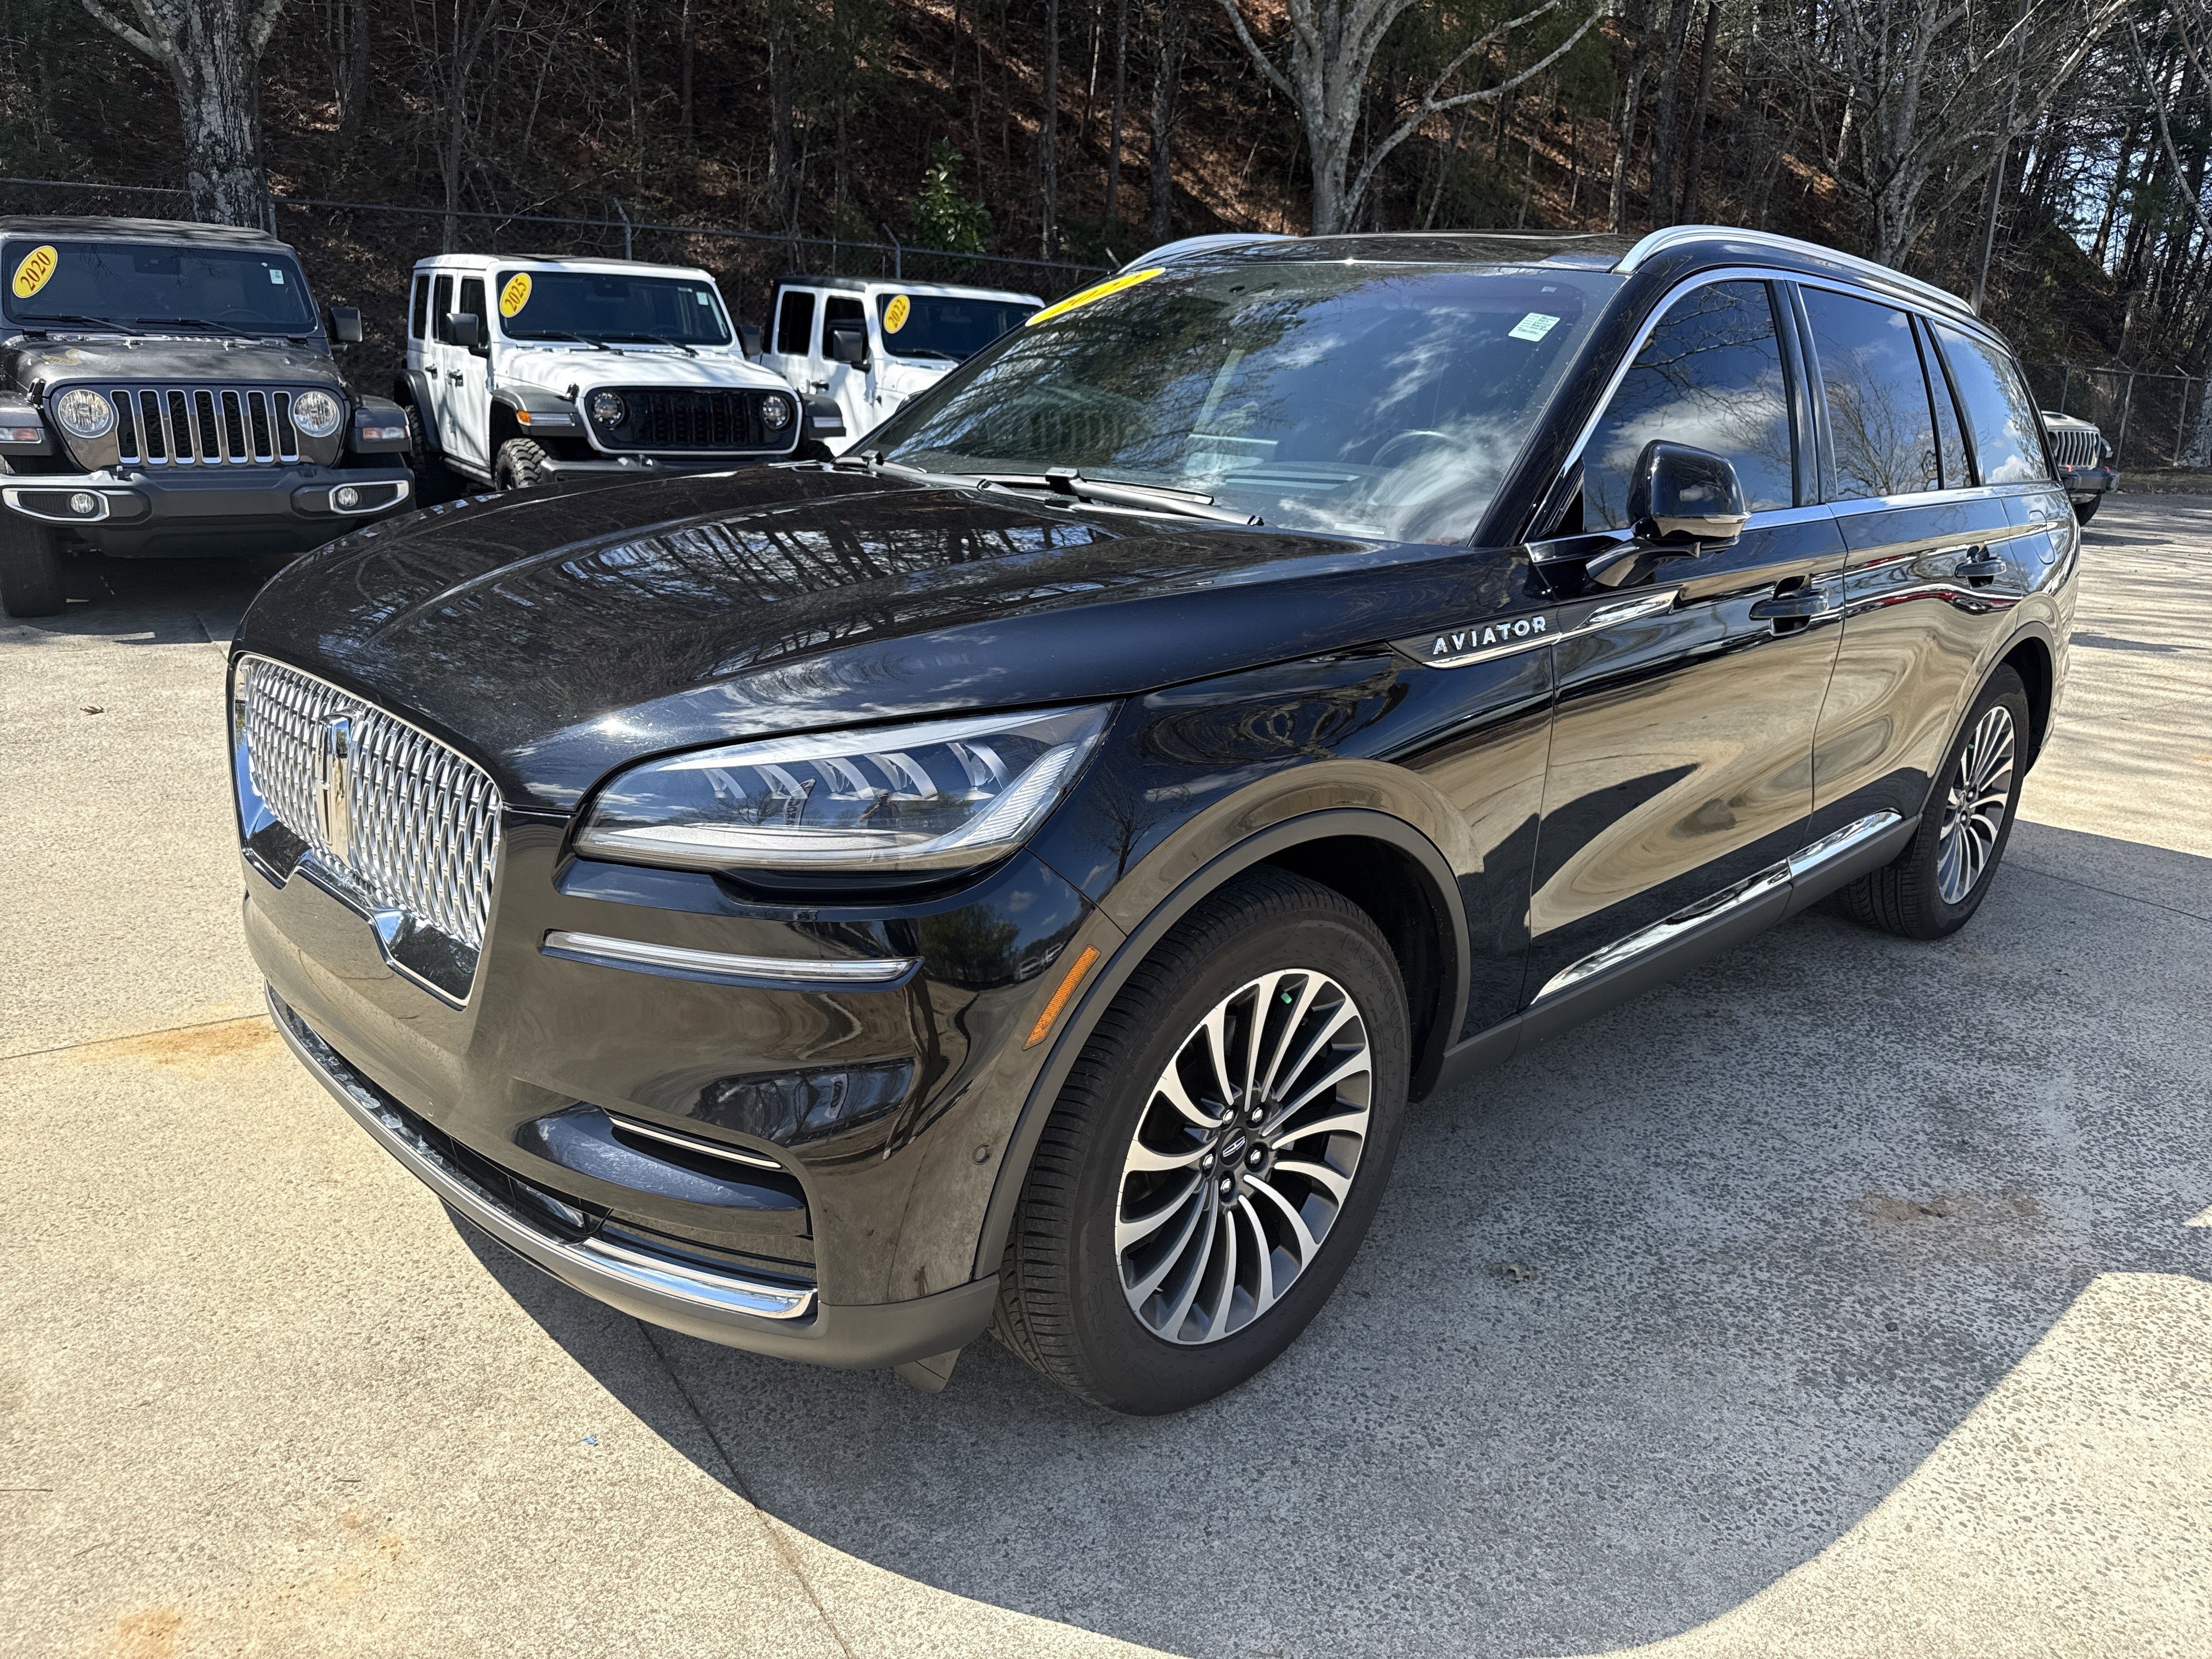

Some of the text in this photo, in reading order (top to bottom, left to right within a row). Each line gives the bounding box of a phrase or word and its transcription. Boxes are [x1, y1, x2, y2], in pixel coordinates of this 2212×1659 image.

[20, 251, 50, 292] 2020
[505, 278, 527, 312] 2025
[888, 299, 906, 329] 2022
[1432, 616, 1546, 655] AVIATOR
